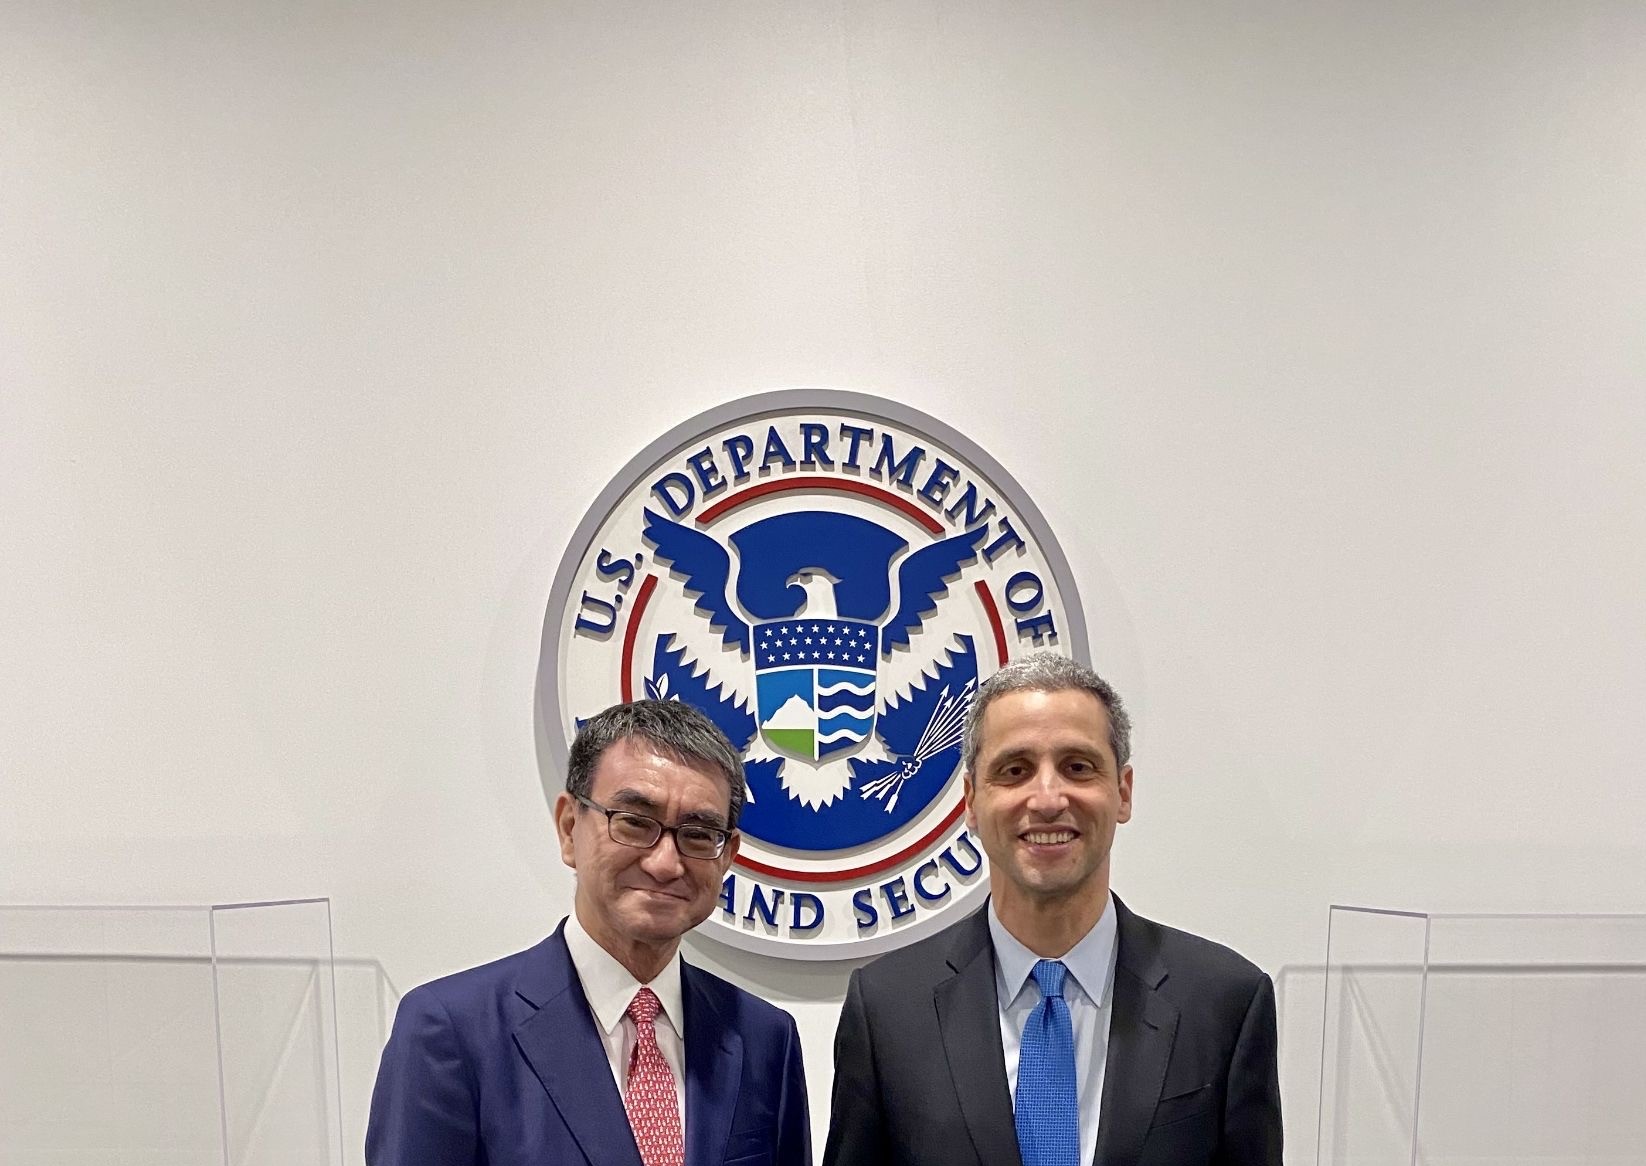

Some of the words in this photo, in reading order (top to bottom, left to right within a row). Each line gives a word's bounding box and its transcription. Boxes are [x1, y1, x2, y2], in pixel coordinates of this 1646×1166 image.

[574, 547, 644, 636] U.S.
[650, 423, 1026, 563] DEPARTMENT
[1004, 571, 1058, 640] OF
[719, 873, 825, 930] AND
[852, 830, 983, 929] SECU
